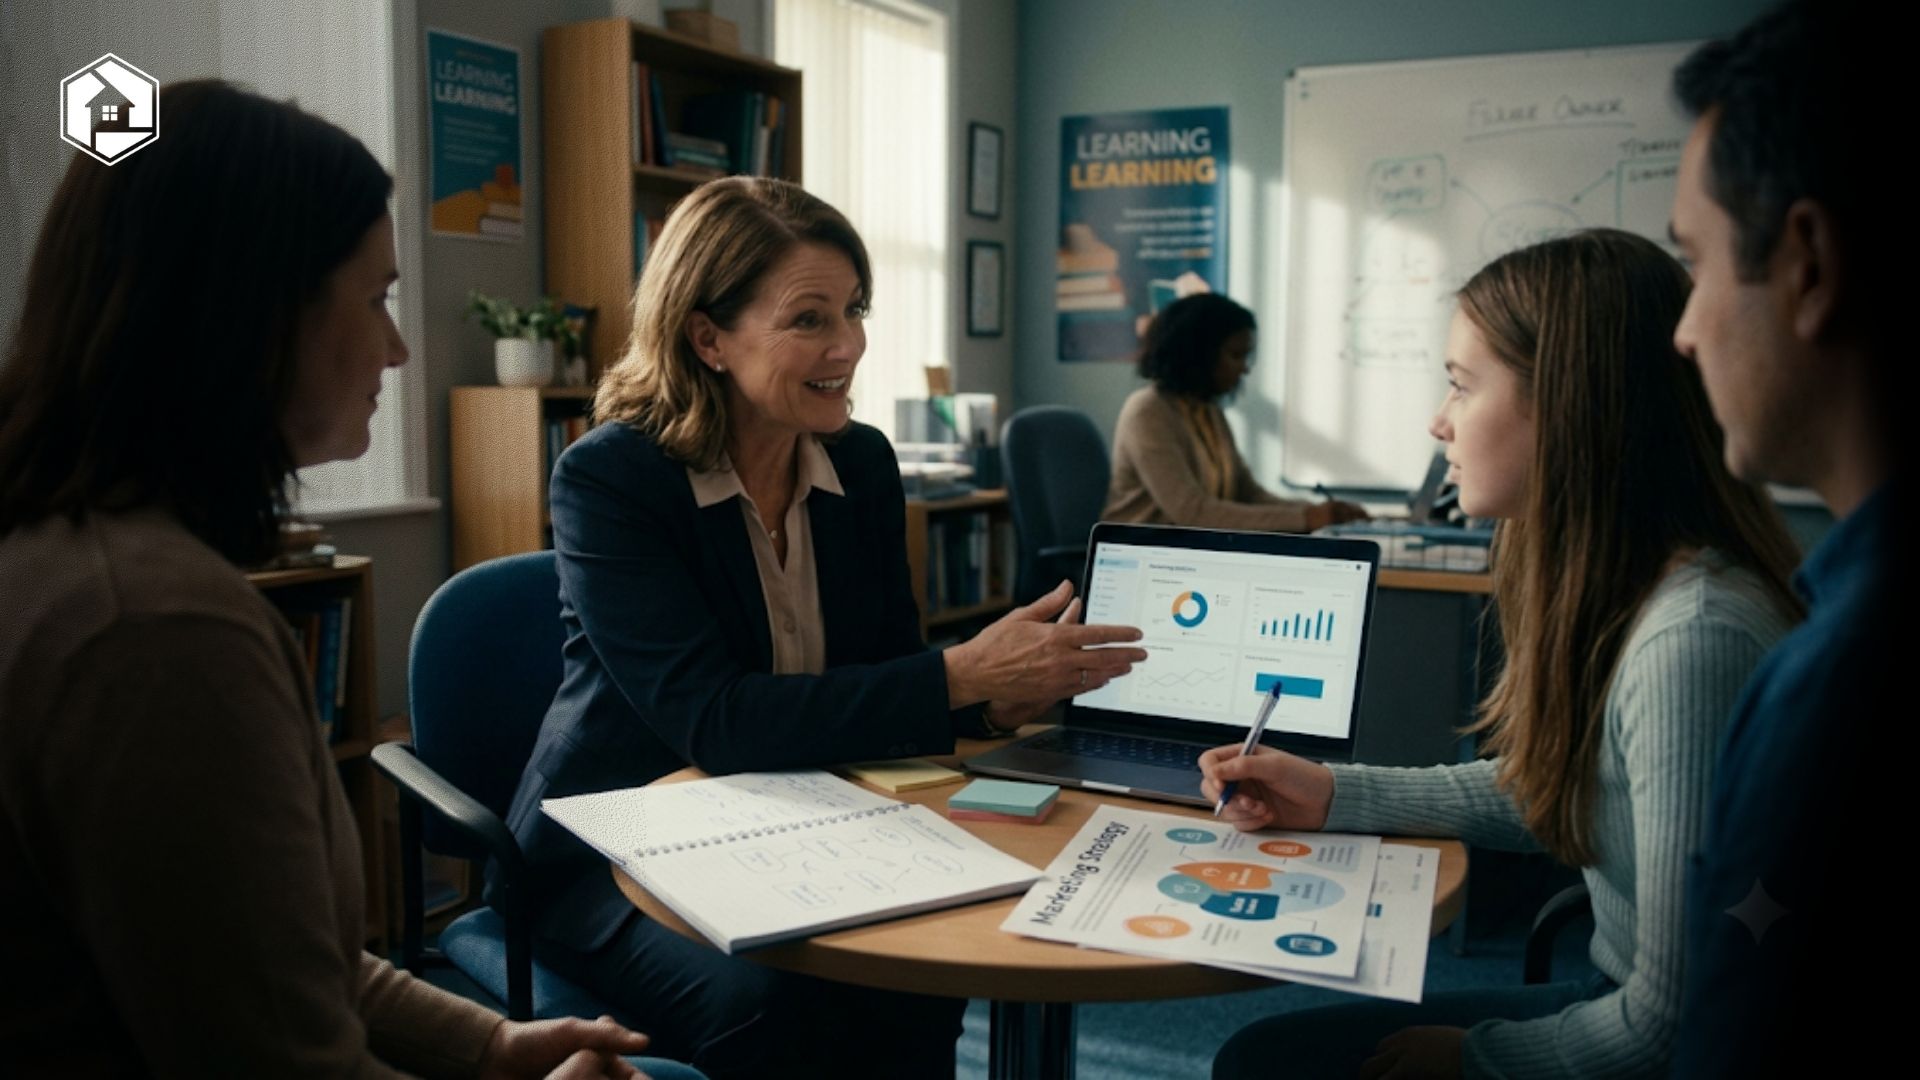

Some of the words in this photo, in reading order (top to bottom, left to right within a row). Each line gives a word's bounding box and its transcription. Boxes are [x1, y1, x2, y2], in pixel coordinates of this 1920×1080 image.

[436, 59, 514, 93] LEARNING
[435, 81, 516, 115] LEARNING
[1077, 127, 1212, 159] LEARNING
[1070, 156, 1217, 190] LEARNING
[1029, 863, 1100, 926] Marketing
